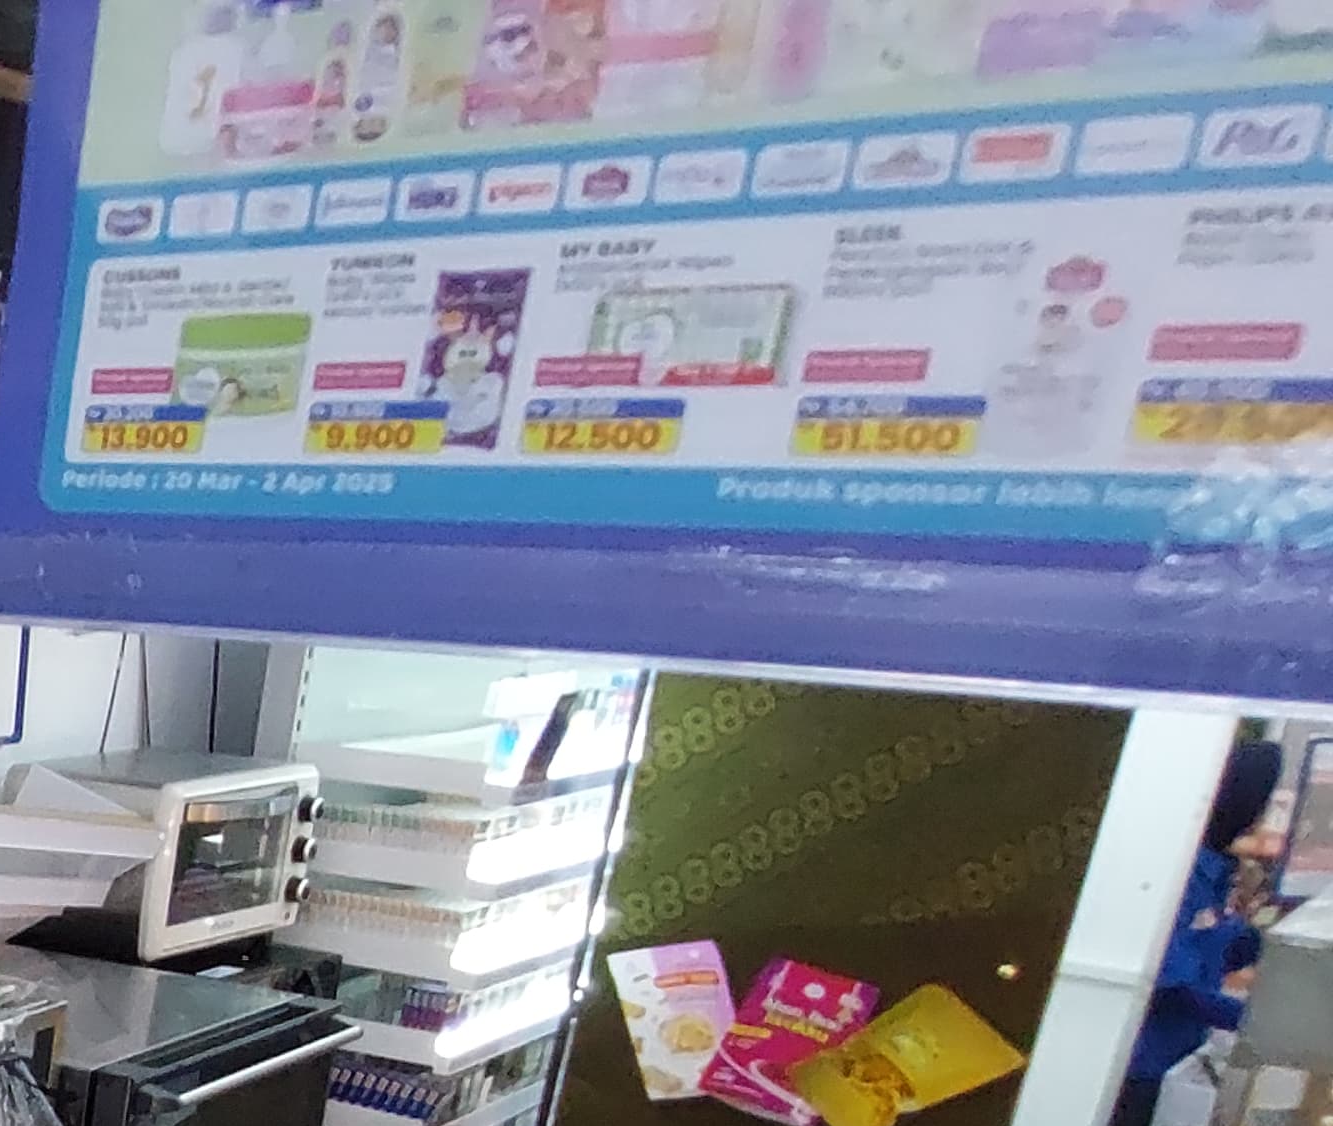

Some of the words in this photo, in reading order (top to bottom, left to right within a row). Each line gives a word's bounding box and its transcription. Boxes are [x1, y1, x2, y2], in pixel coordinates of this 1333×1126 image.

[99, 425, 189, 450] 13.900
[326, 424, 415, 450] 9.900
[543, 424, 661, 450] 12.500
[62, 468, 146, 491] Periode
[196, 471, 242, 491] Mar
[280, 472, 326, 496] Apr
[717, 477, 833, 502] Produk
